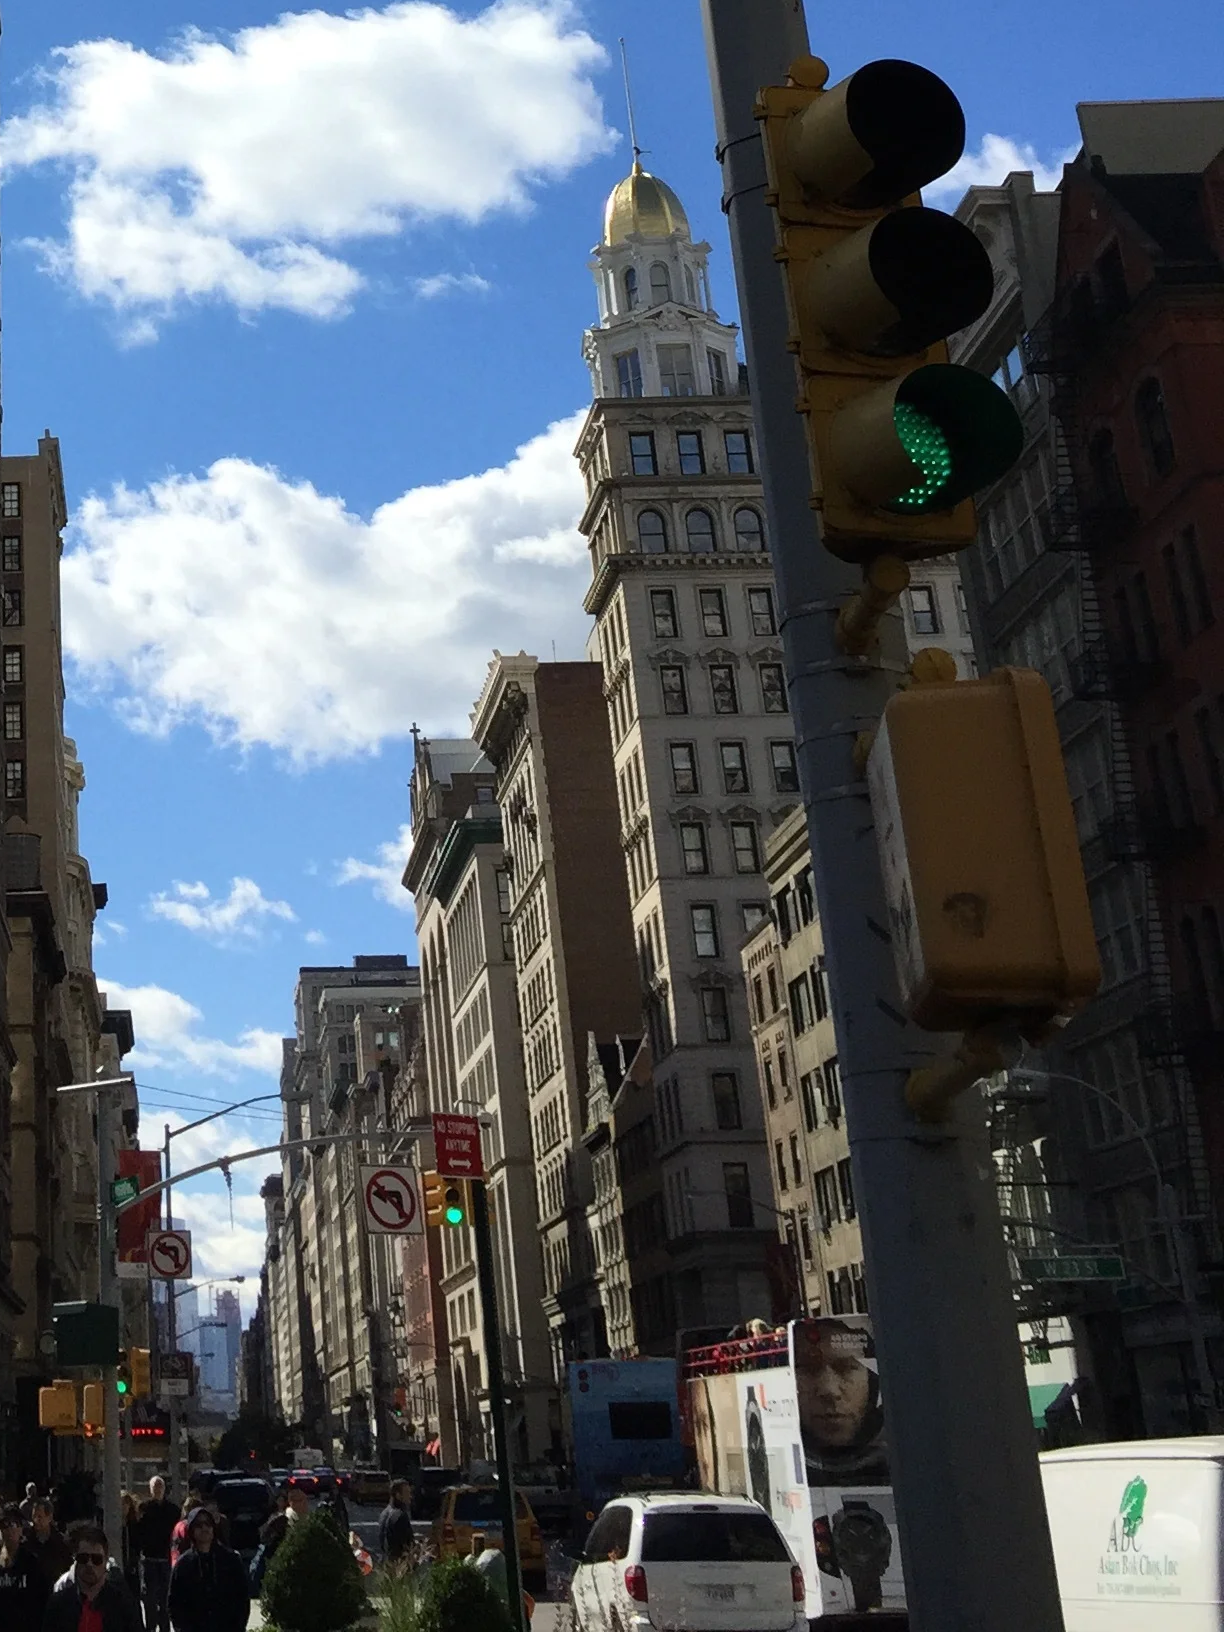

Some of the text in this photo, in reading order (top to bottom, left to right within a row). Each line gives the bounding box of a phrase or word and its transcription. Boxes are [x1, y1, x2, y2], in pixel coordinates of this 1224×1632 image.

[436, 1120, 476, 1136] NO STOPPING
[445, 1139, 472, 1153] ANYTIME
[1041, 1260, 1057, 1276] W
[1107, 1516, 1144, 1553] ABC
